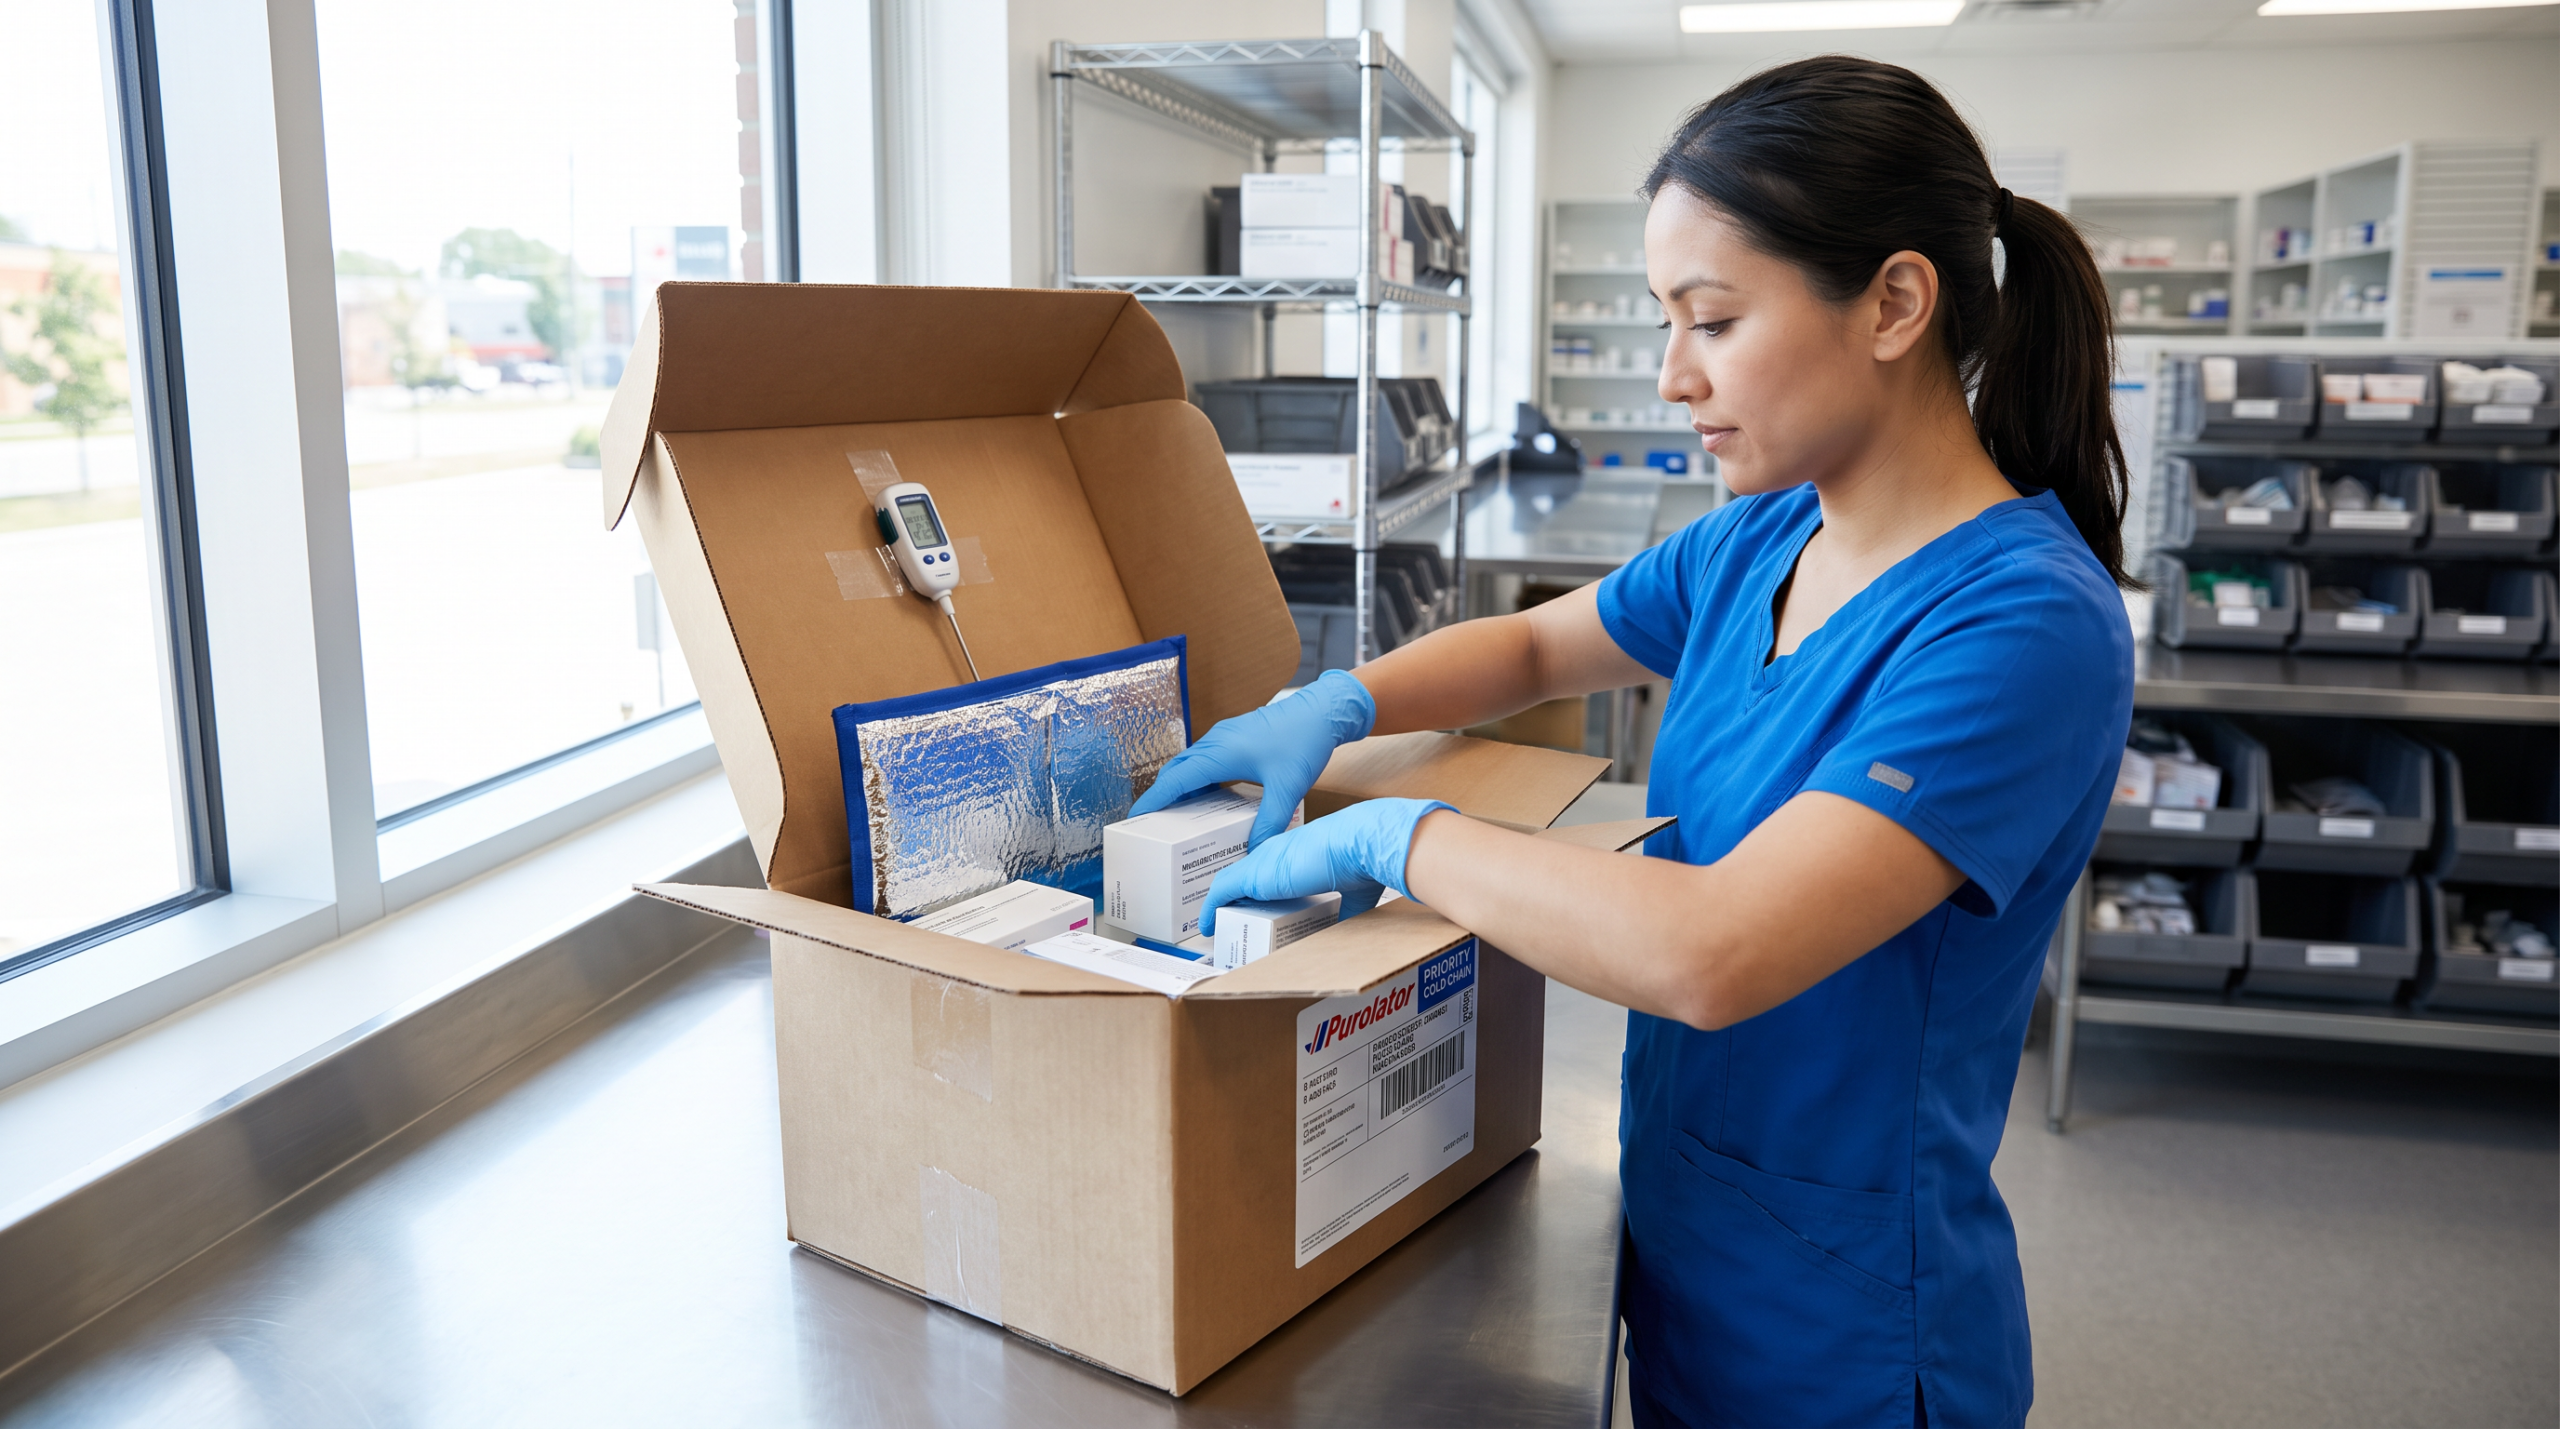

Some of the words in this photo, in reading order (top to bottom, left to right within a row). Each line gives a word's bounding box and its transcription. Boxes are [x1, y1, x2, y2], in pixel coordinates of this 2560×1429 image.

[1424, 947, 1470, 982] PRIORITY
[1424, 977, 1447, 998] COLD
[1447, 963, 1472, 985] CHAIN
[1323, 982, 1415, 1048] Purolator
